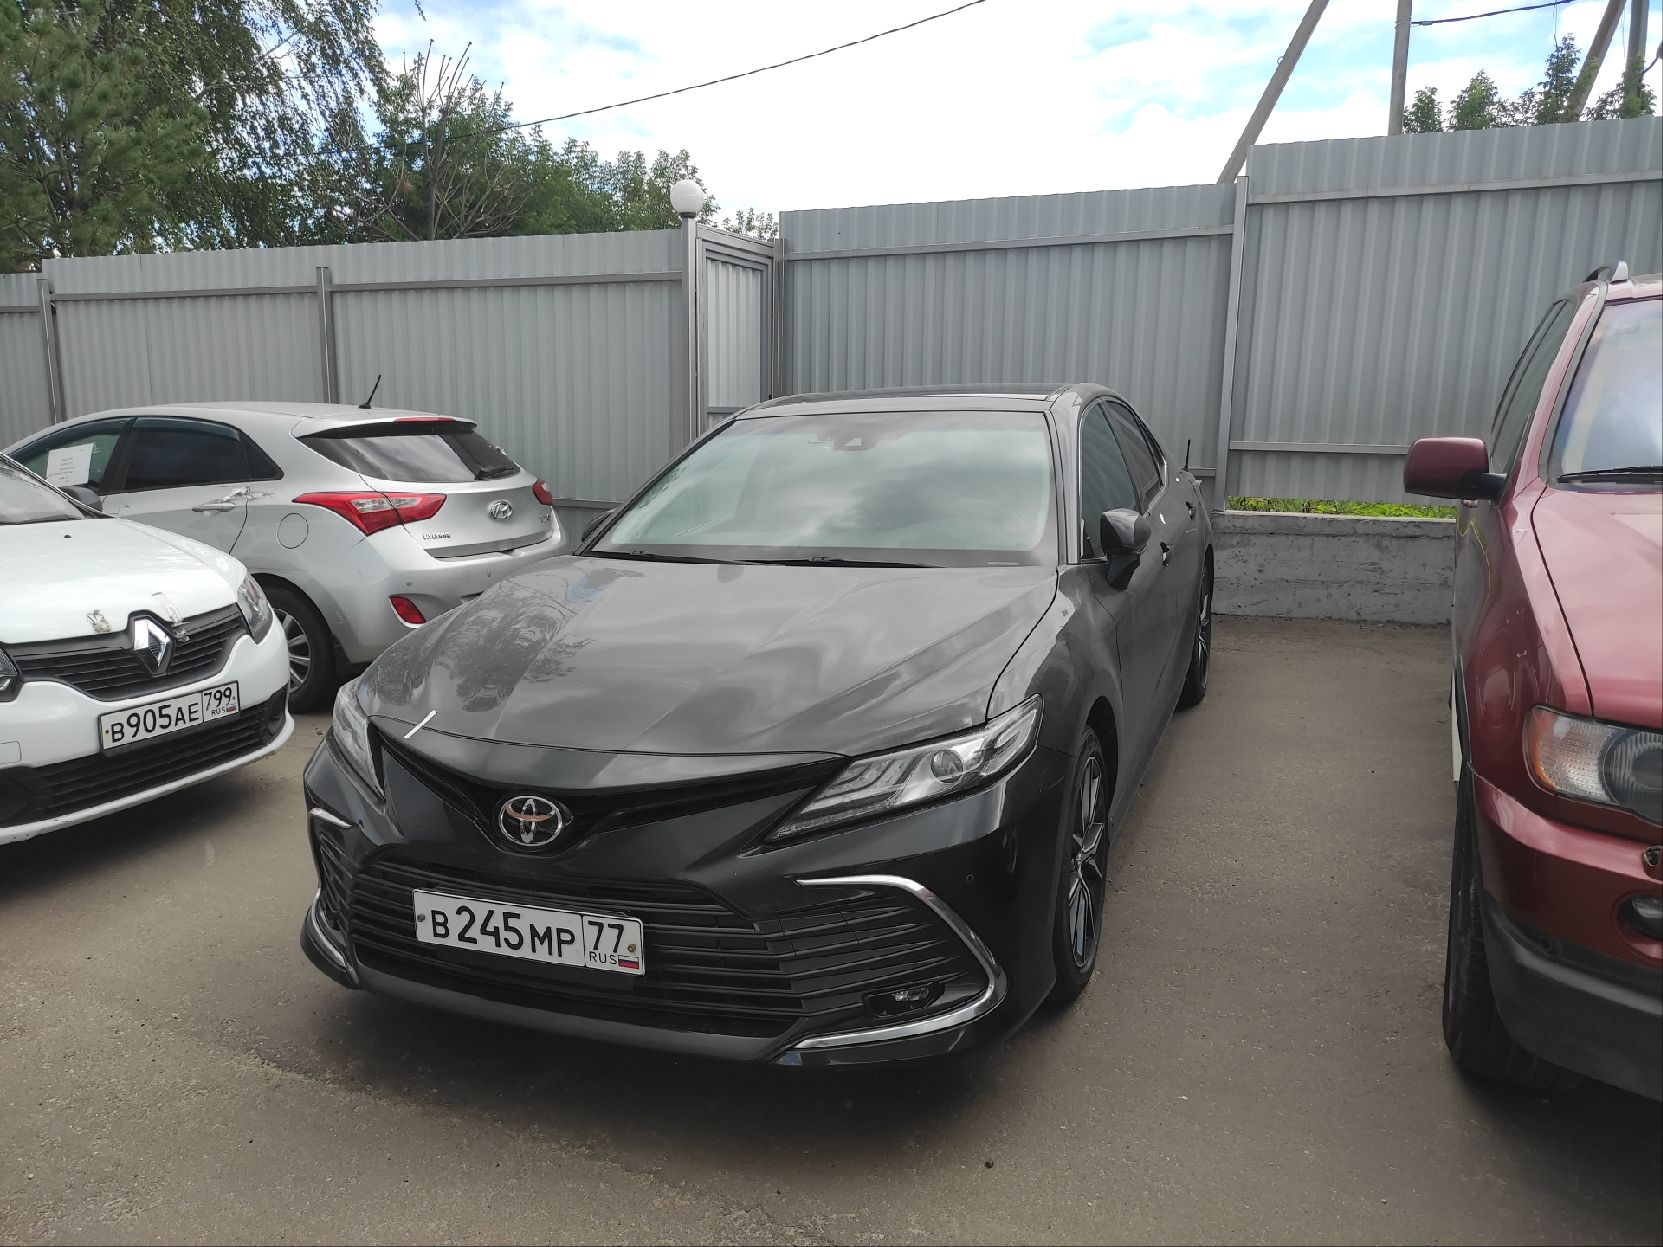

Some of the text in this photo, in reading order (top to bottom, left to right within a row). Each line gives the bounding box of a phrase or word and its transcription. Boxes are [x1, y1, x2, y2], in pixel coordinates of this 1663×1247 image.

[111, 686, 232, 743] В905АЕ 799
[211, 706, 226, 717] RUS
[430, 905, 625, 958] В245МР 77
[588, 951, 618, 966] RUS
